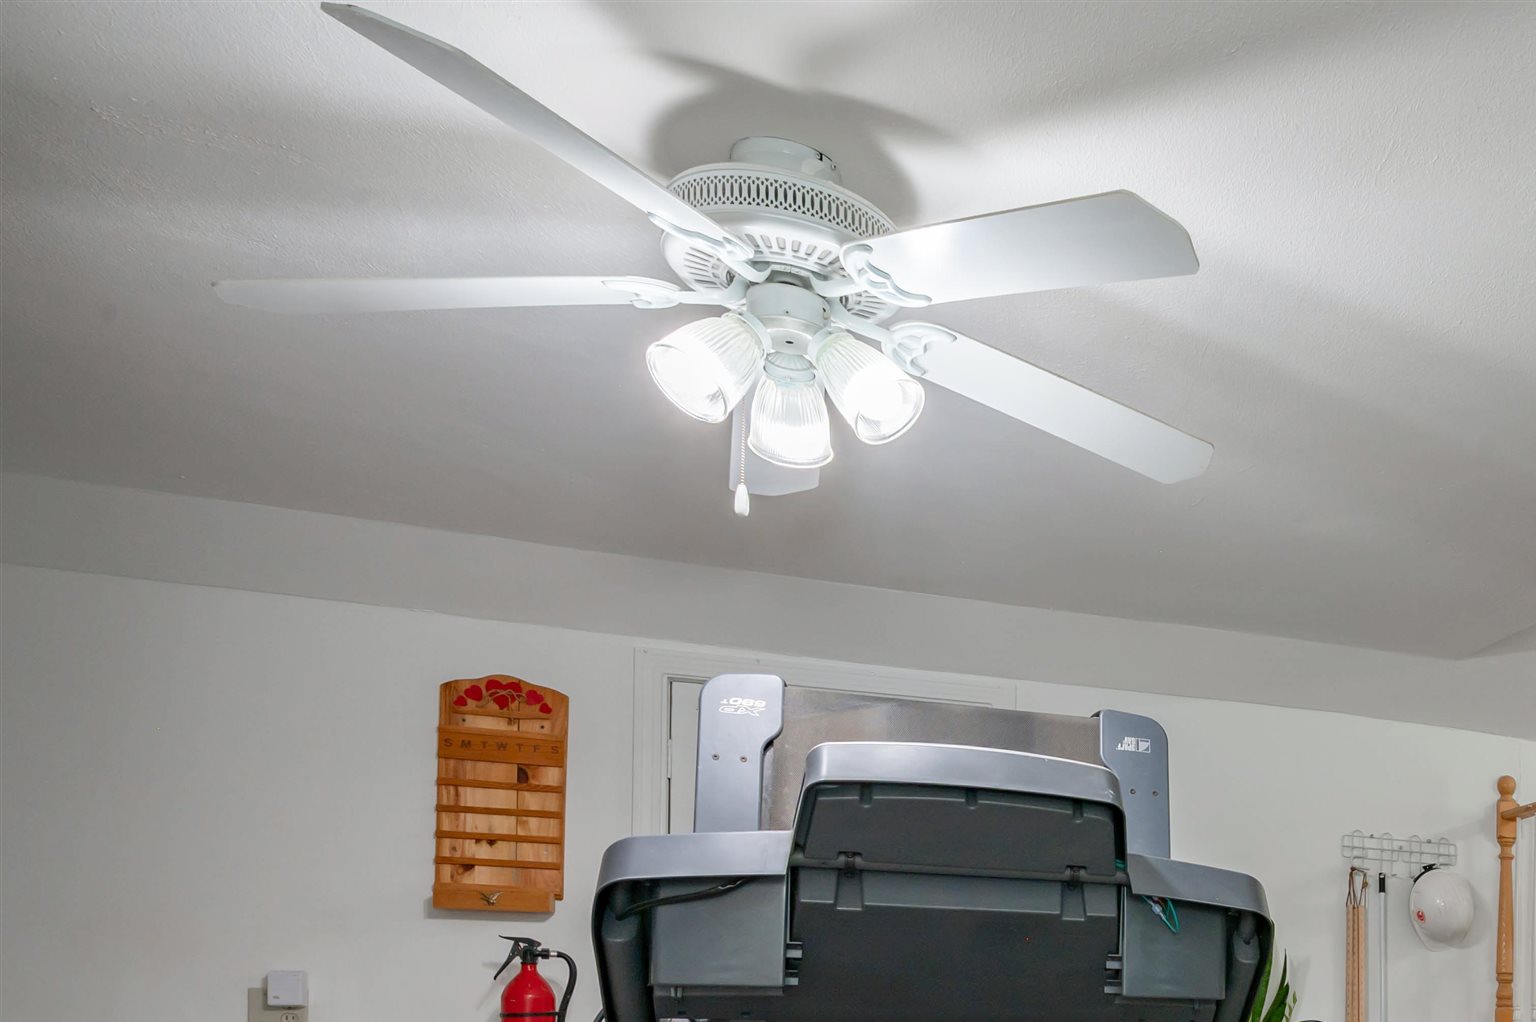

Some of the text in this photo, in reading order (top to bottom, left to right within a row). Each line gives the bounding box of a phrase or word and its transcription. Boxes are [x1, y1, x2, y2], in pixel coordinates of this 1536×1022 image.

[444, 738, 559, 754] S M T W T F S
